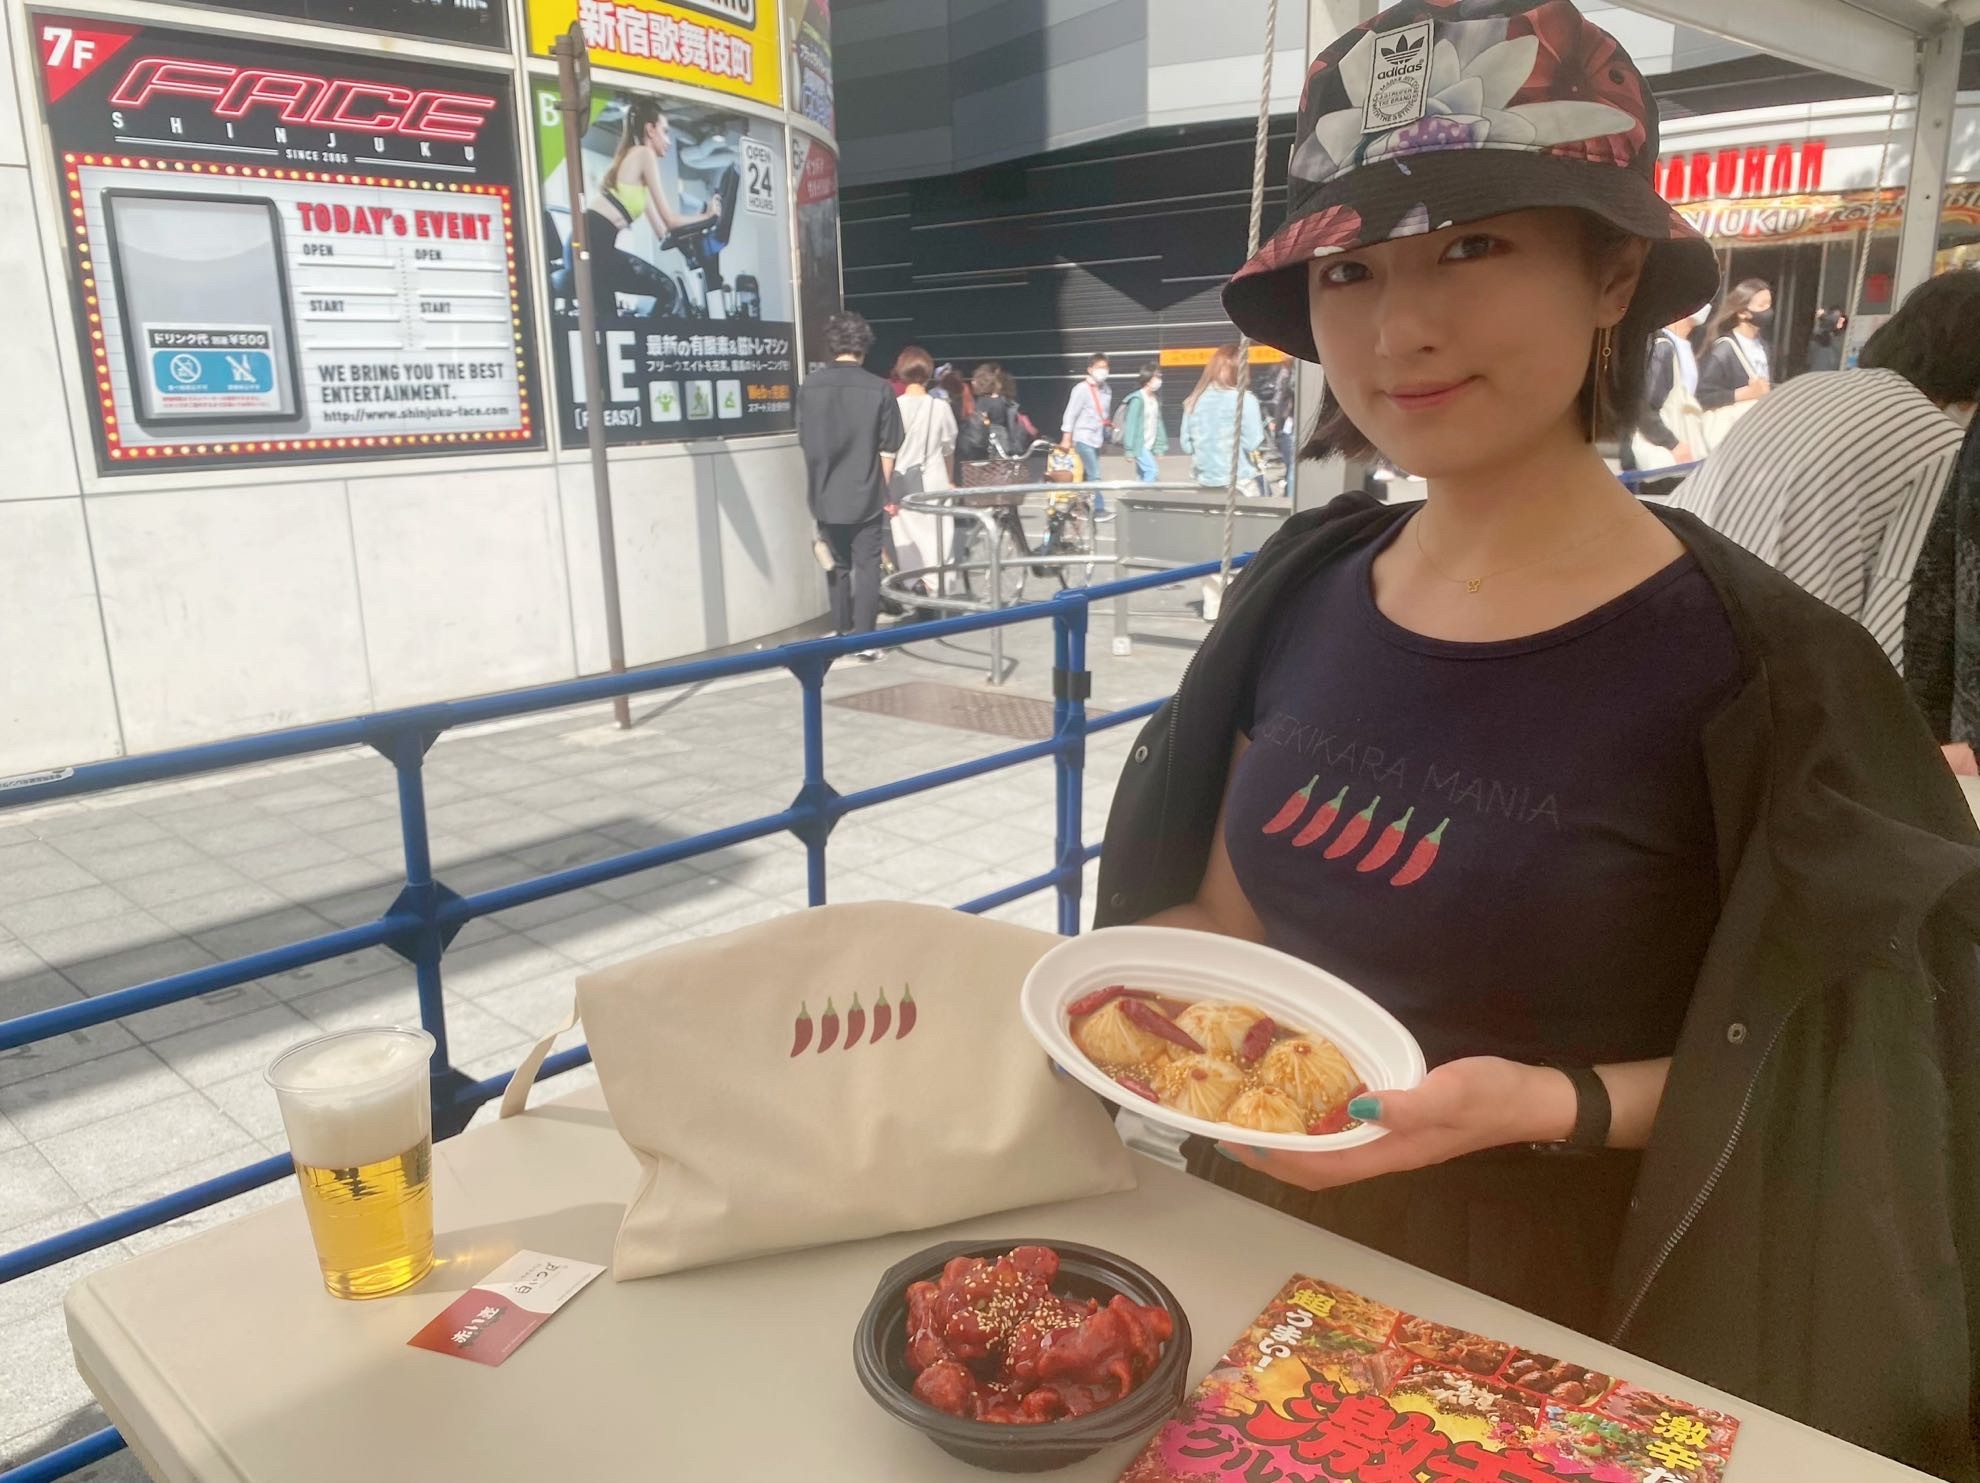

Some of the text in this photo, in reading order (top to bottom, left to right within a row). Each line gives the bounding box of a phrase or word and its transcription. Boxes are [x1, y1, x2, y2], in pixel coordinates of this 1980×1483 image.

[43, 26, 96, 70] 7F
[578, 0, 753, 84] 新宿歌舞伎町
[1377, 64, 1422, 80] adidas
[109, 56, 498, 142] FACE
[285, 148, 319, 162] SINCE
[746, 145, 771, 162] OPEN
[748, 162, 772, 197] 24
[1654, 141, 1826, 200] ARUHAN
[749, 197, 774, 211] HOURS
[297, 201, 491, 241] TODAY's EVENT
[302, 243, 334, 257] OPEN
[414, 249, 443, 261] OPEN
[309, 300, 345, 312] START
[420, 302, 451, 314] START
[319, 362, 504, 383] WE BRING YOU THE BEST
[321, 383, 457, 404] ENTERTAINMENT.
[1421, 762, 1561, 830] MANIA
